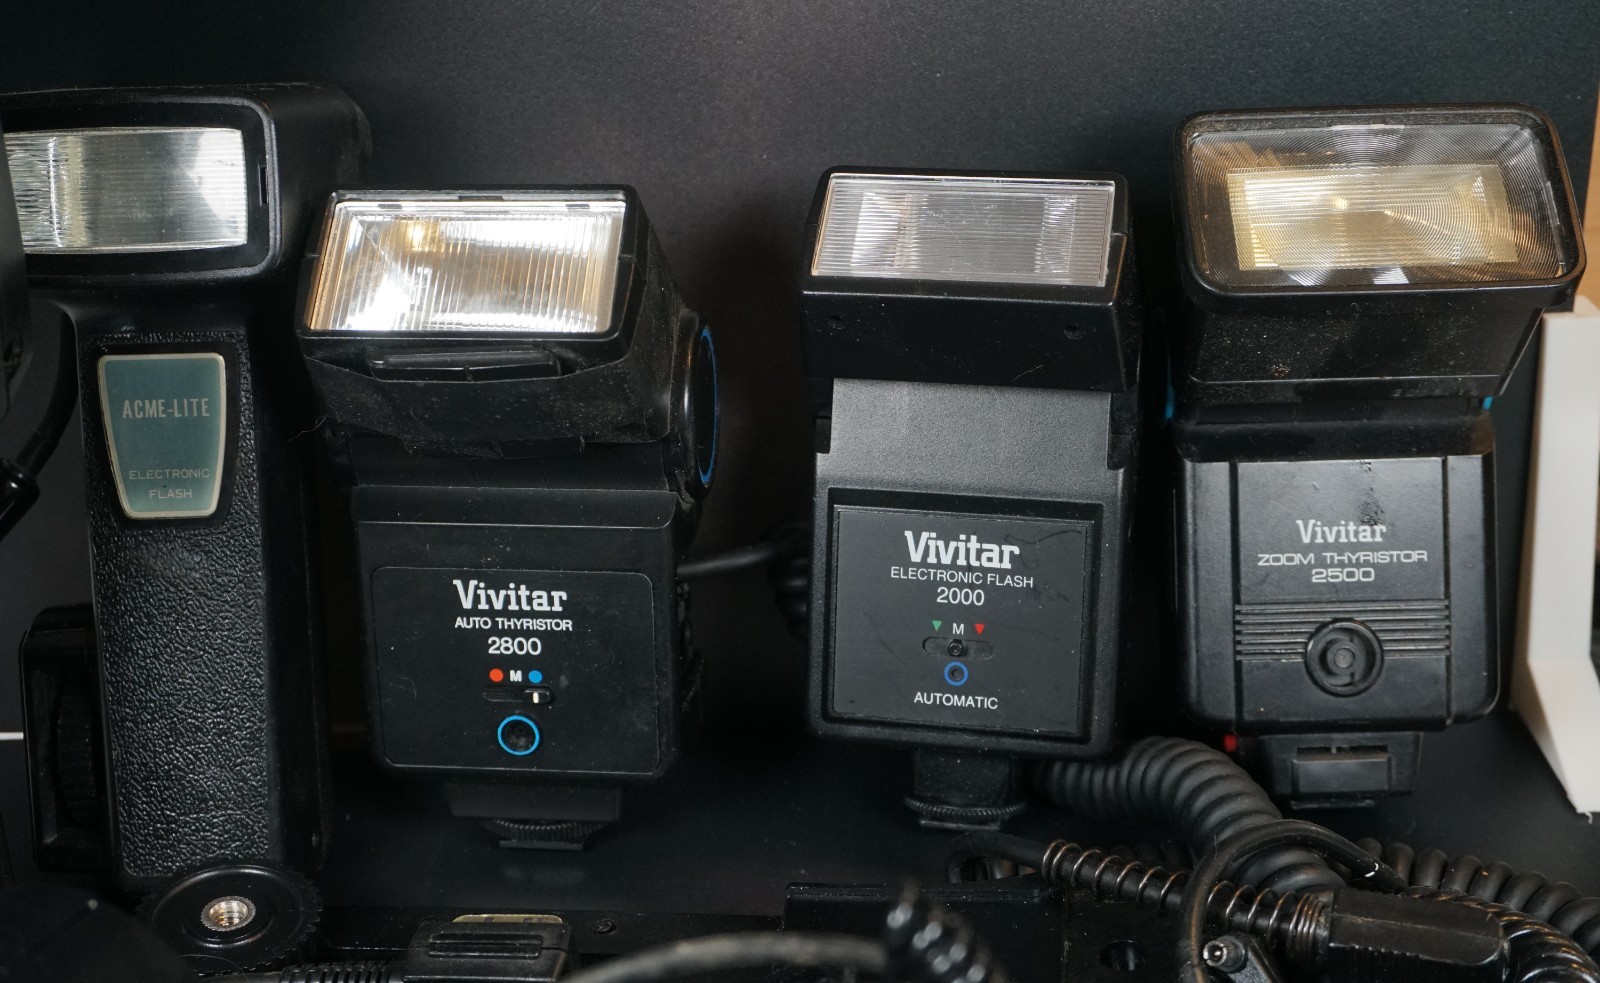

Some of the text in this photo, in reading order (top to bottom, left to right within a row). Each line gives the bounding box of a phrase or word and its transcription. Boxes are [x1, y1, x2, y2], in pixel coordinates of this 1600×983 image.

[123, 398, 210, 418] ACME-LITE
[129, 468, 210, 480] ELECTRONIC
[149, 489, 192, 499] FLASH
[1296, 519, 1387, 544] Vivitar
[904, 530, 1020, 569] Vivitar
[1257, 550, 1428, 566] ZOOM THYRISTOR
[890, 566, 1034, 588] ELECTRONIC FLASH
[1311, 567, 1375, 583] 2500
[453, 579, 567, 612] Vivitar
[936, 586, 985, 606] 2000
[454, 616, 573, 631] AUTO THYRISTOR
[952, 622, 965, 635] M
[488, 636, 542, 656] 2800
[509, 669, 522, 682] M
[914, 691, 998, 710] AUTOMATIC
